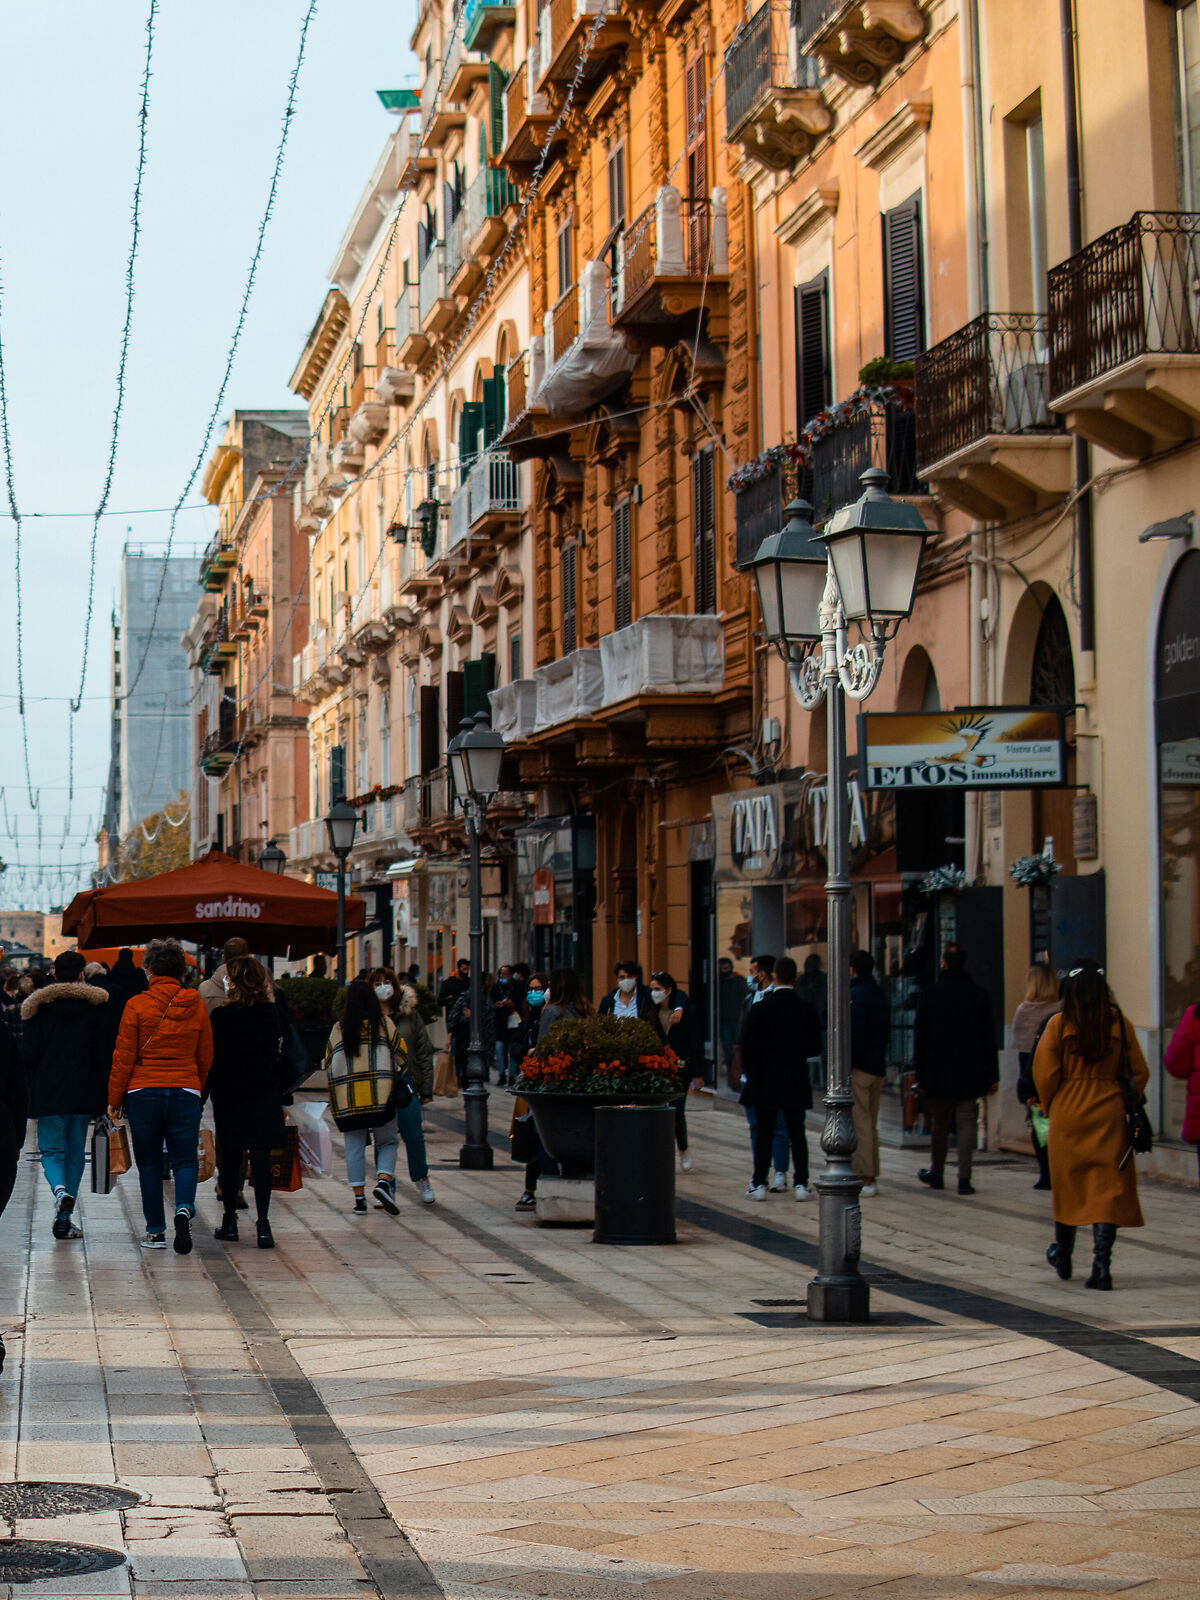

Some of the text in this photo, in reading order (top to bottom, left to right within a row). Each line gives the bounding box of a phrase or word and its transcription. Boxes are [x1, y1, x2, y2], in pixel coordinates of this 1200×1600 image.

[872, 764, 1057, 786] ETOS immobiliare
[732, 794, 777, 853] TATA
[195, 895, 261, 919] sandrino
